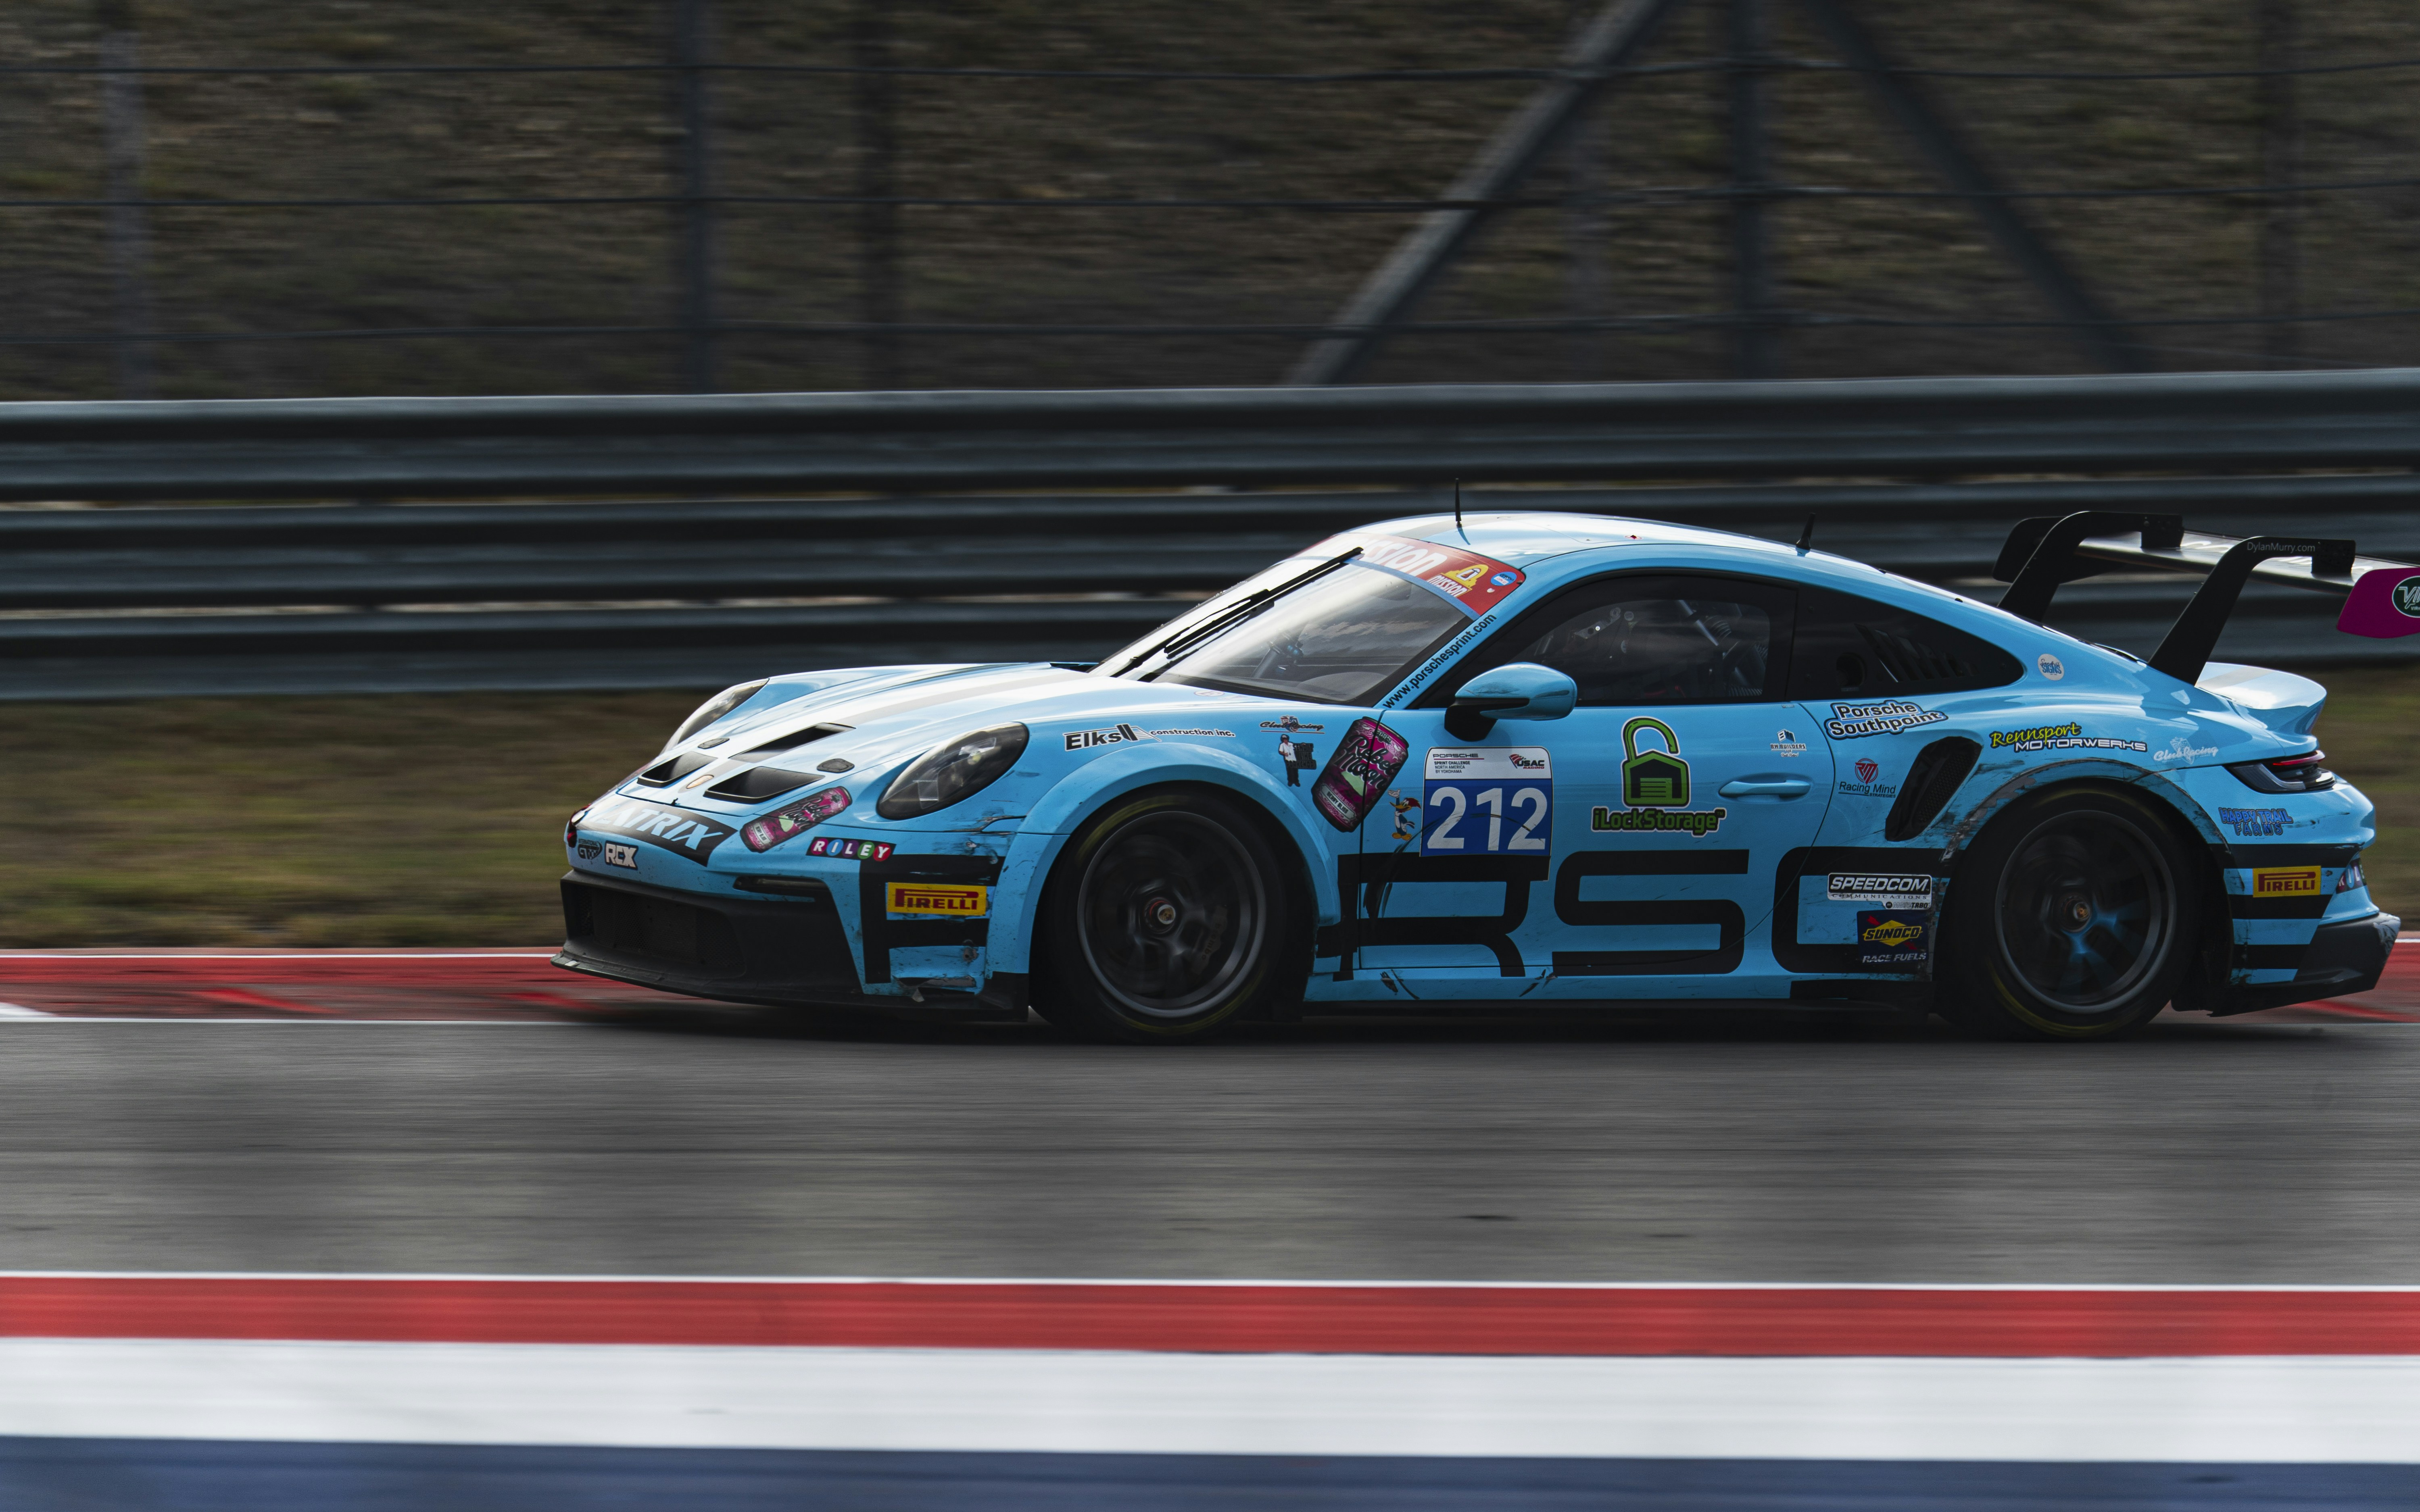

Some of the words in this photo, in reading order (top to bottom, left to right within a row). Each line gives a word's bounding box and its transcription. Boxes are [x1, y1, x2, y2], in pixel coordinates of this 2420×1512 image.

[2247, 542, 2315, 554] DylanMurry.com
[1383, 613, 1497, 709] www.porschesprint.com
[2041, 664, 2062, 674] SIGNS
[1836, 703, 1917, 718] Porsche
[1830, 712, 1941, 735] Southpoint
[1066, 731, 1122, 750] Elks
[1991, 723, 2080, 748] Rennsport
[2015, 738, 2146, 751] MOTORWERKS
[1347, 735, 1402, 775] Rebel
[2154, 747, 2183, 761] Club
[2183, 746, 2219, 757] Racing
[1333, 749, 1388, 789] Moon
[1839, 781, 1870, 794] Racing
[1873, 784, 1896, 794] Mind
[1327, 791, 1339, 804] BERRY
[1337, 802, 1349, 814] BLISS
[1427, 787, 1548, 851] 212
[2220, 809, 2258, 823] HAPPY
[2258, 809, 2292, 823] TRAIL
[2235, 823, 2282, 835] FARMS
[605, 843, 638, 868] RCX
[813, 840, 890, 859] RILEY
[1830, 877, 1929, 891] SPEEDCOM
[2258, 871, 2316, 892] PIRELLI
[895, 888, 979, 910] PIRELLI
[1865, 927, 1921, 940] SUNOCO
[1862, 954, 1892, 963] RACE
[1894, 953, 1926, 962] FUELS
